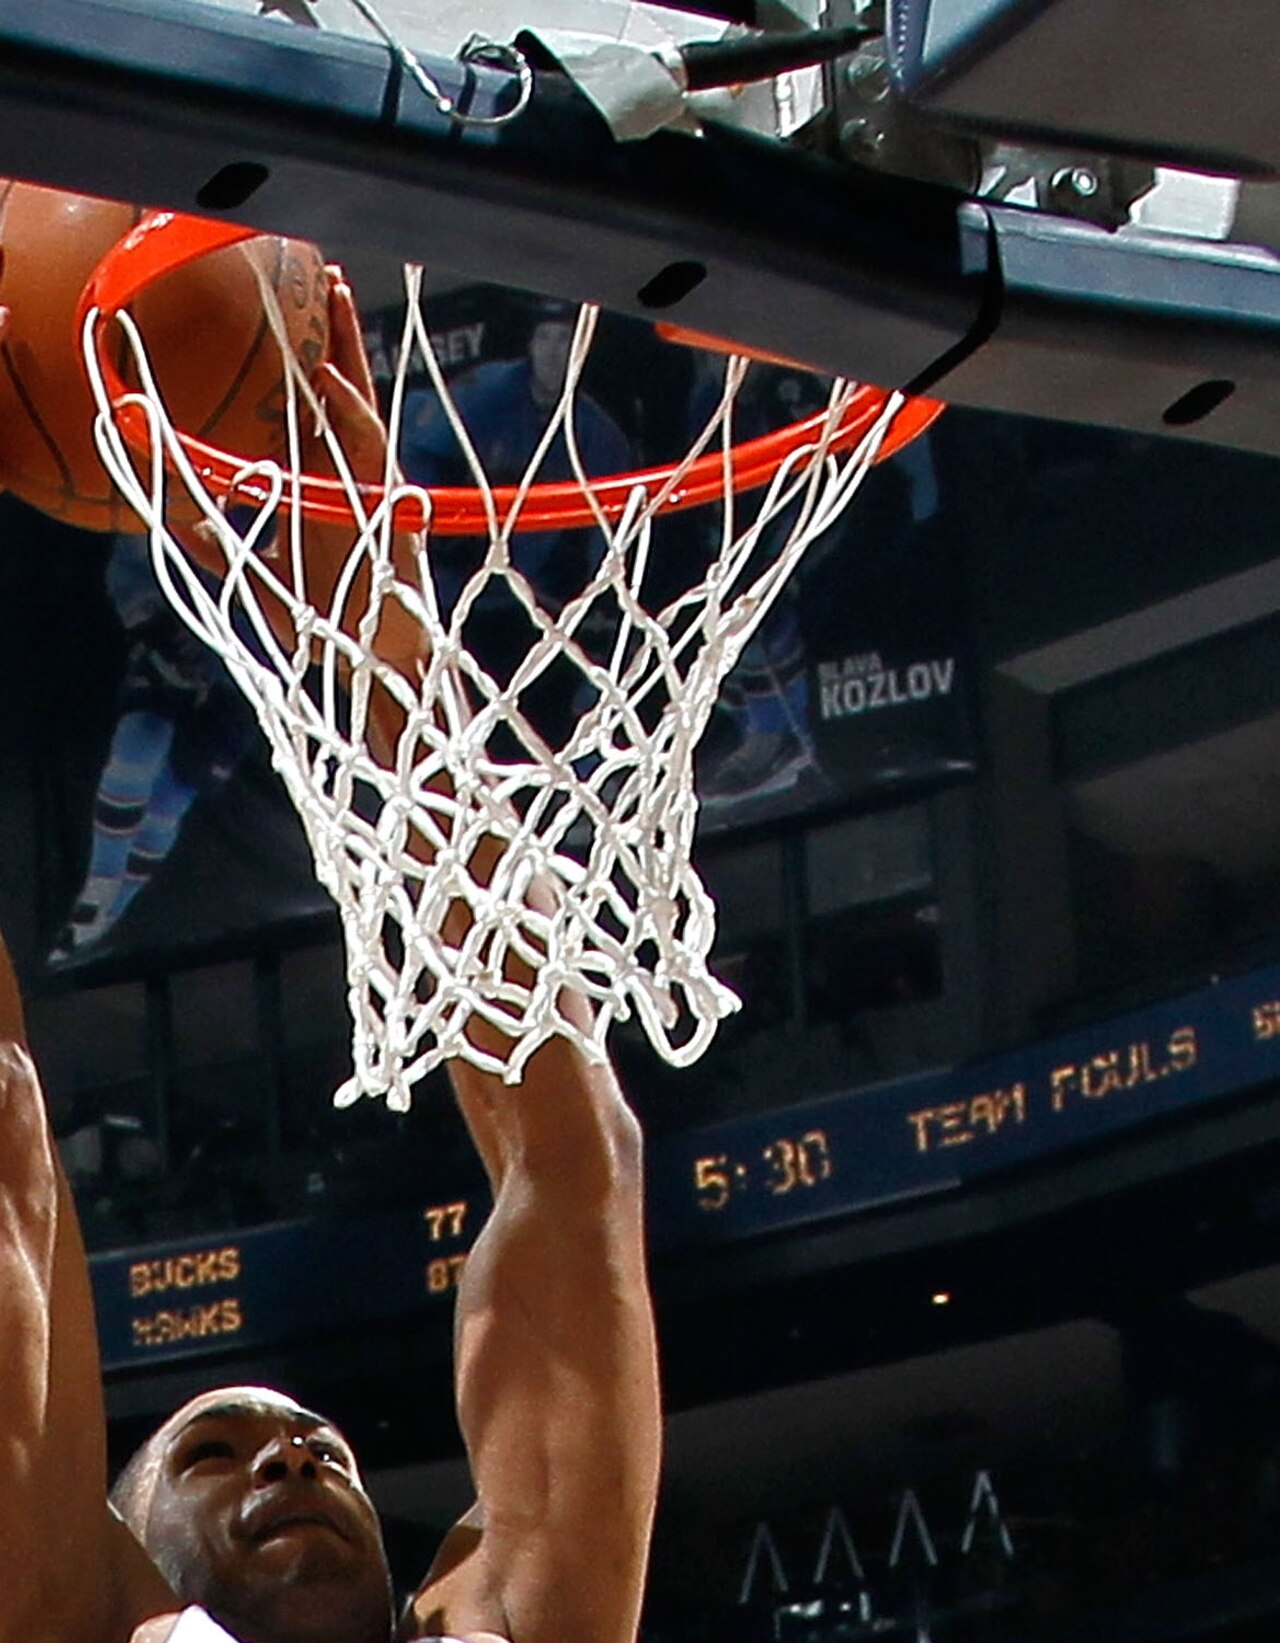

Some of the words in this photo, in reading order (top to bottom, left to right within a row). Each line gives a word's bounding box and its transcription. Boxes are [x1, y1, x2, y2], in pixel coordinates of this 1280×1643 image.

[820, 657, 956, 720] KOZLOV
[907, 1081, 1026, 1153] TEAM
[1049, 1025, 1199, 1112] FOULS
[693, 1129, 833, 1210] 5:30
[424, 1202, 468, 1241] 77
[129, 1247, 241, 1298] BUCKS
